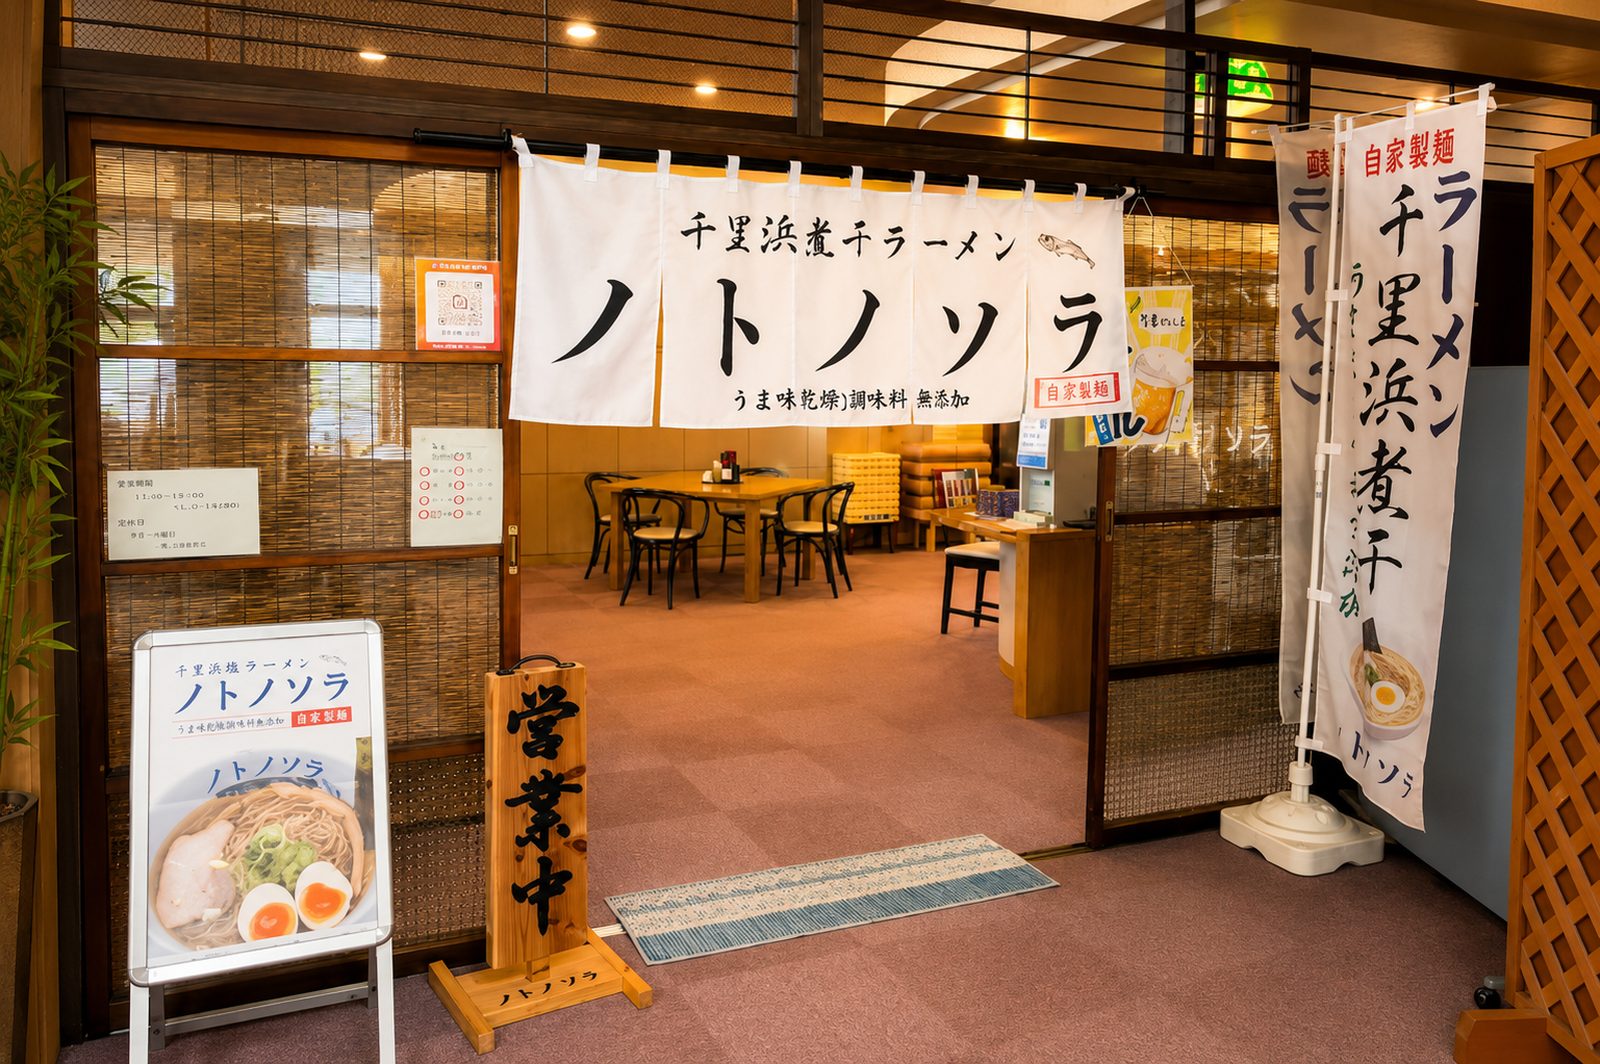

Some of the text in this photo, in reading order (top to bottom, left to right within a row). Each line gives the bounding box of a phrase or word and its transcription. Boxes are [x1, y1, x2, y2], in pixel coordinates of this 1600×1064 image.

[1364, 128, 1455, 178] 自家製麺
[680, 210, 1017, 261] 千里浜煮干ラーメン
[552, 277, 1104, 378] ノトノソラ
[1429, 171, 1478, 438] ラーメン
[1047, 380, 1109, 402] 自家製麺
[1357, 183, 1424, 596] 千里浜煮干
[175, 658, 310, 677] 千里浜塩ラーメン
[175, 672, 349, 715] ノトノソラ
[296, 709, 348, 725] 自家製麺
[207, 756, 324, 794] ノトノソラ
[505, 684, 583, 937] 営業中
[500, 971, 597, 1007] ノトノソラ
